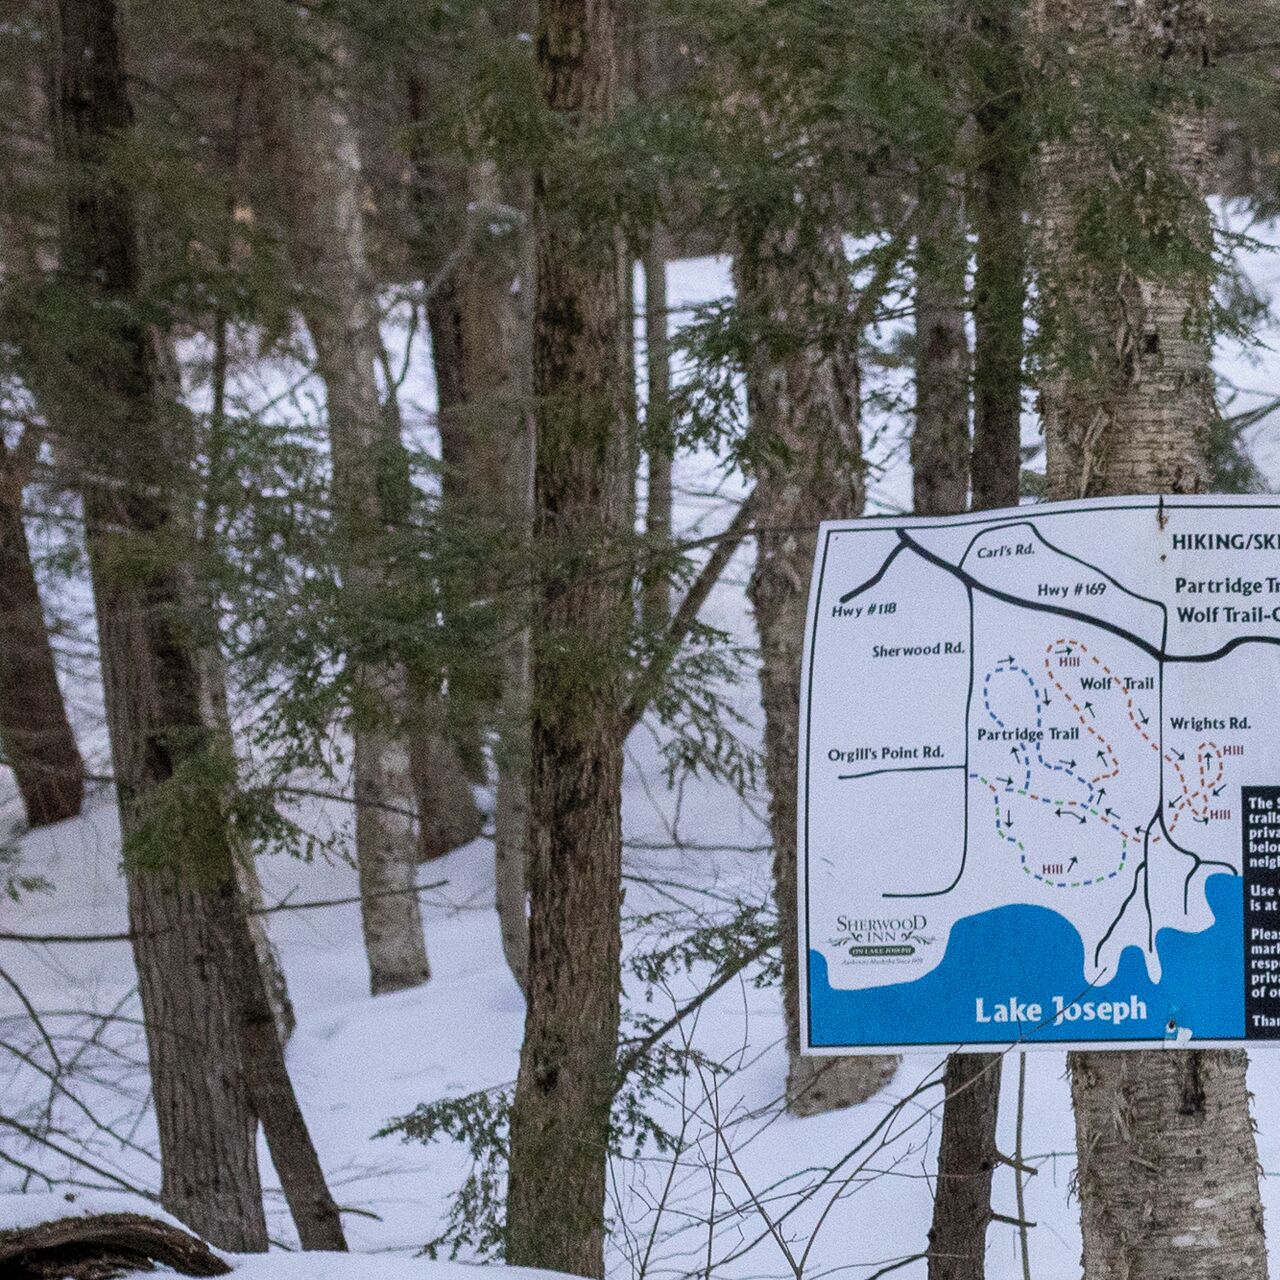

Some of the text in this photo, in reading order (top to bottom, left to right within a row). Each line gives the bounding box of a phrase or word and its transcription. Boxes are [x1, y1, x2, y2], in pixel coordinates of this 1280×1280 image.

[978, 543, 1036, 558] Carl's Rd.
[1038, 582, 1106, 598] Hwy #169
[1176, 578, 1262, 596] Partridge
[832, 602, 896, 618] Hwy #118
[1176, 606, 1218, 622] Wolf
[872, 642, 964, 658] Sherwood Rd.
[1080, 676, 1154, 692] Wolf Trail
[1170, 716, 1251, 732] Wrights Rd.
[978, 728, 1080, 742] Partridge Trail
[828, 746, 944, 762] Orgill's Point Rd.
[1248, 796, 1272, 810] The
[1250, 884, 1274, 896] Use
[1250, 900, 1260, 910] is
[1264, 900, 1278, 910] at
[837, 915, 927, 932] SHERWOOD
[867, 932, 896, 942] INN
[1252, 986, 1266, 998] of
[976, 994, 1146, 1026] Lake Joseph
